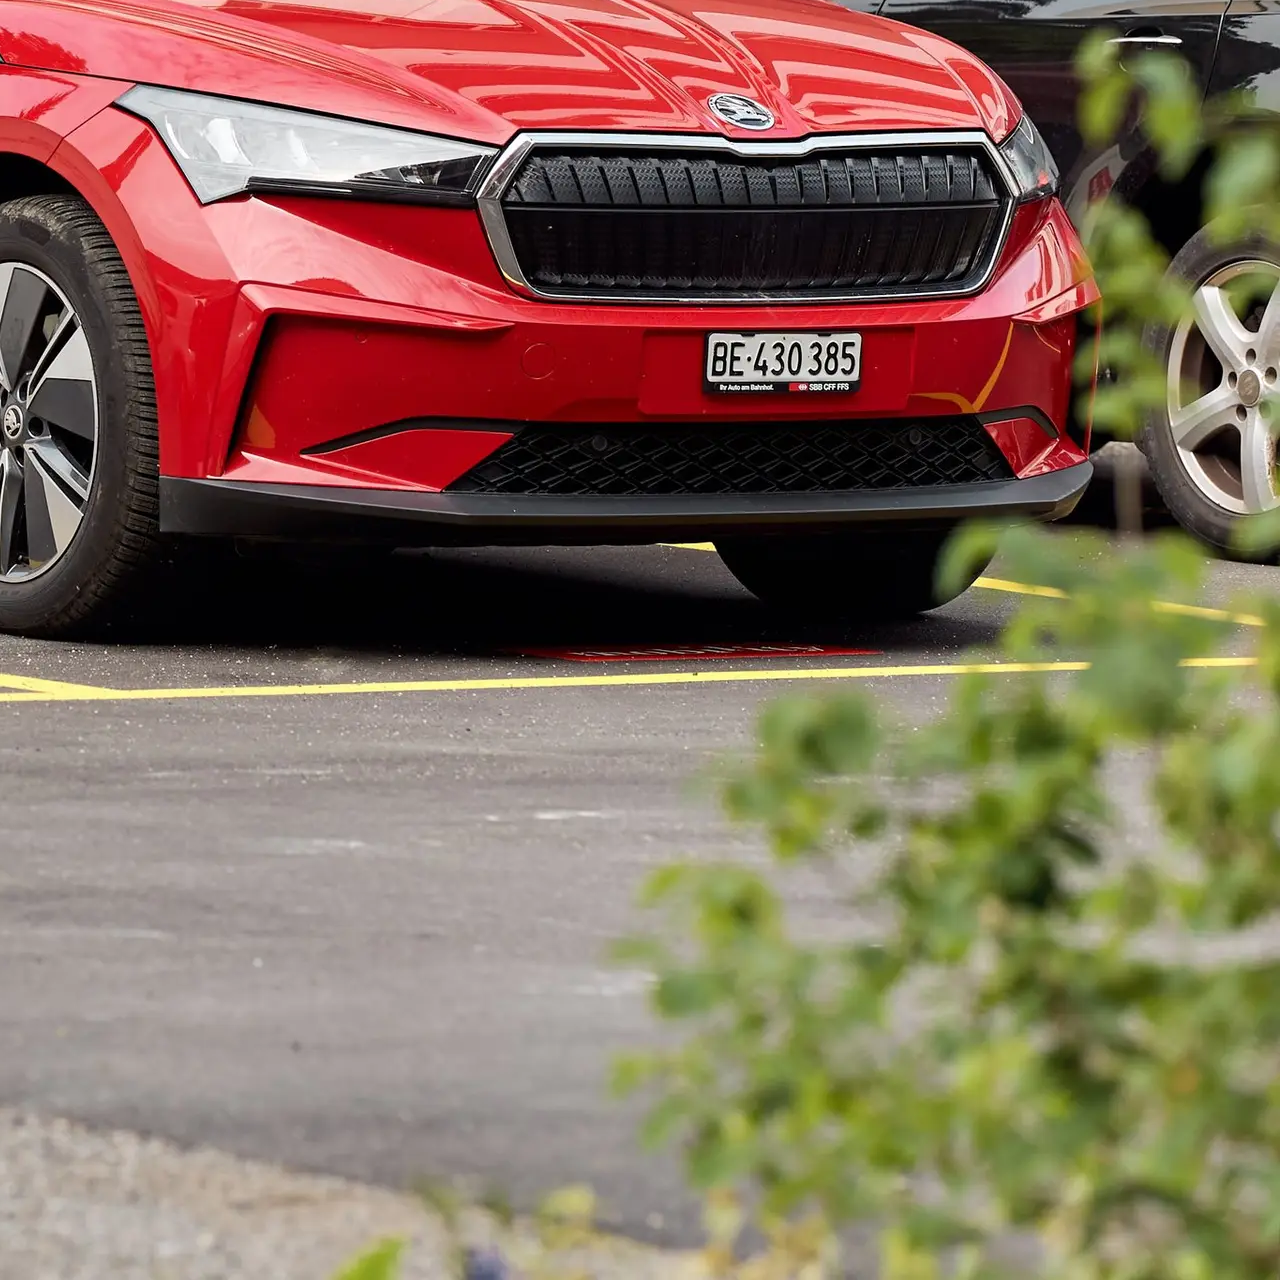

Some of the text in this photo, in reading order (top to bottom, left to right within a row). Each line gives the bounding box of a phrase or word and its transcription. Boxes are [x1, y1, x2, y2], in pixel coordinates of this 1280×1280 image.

[809, 383, 850, 391] SBB CFF FFS
